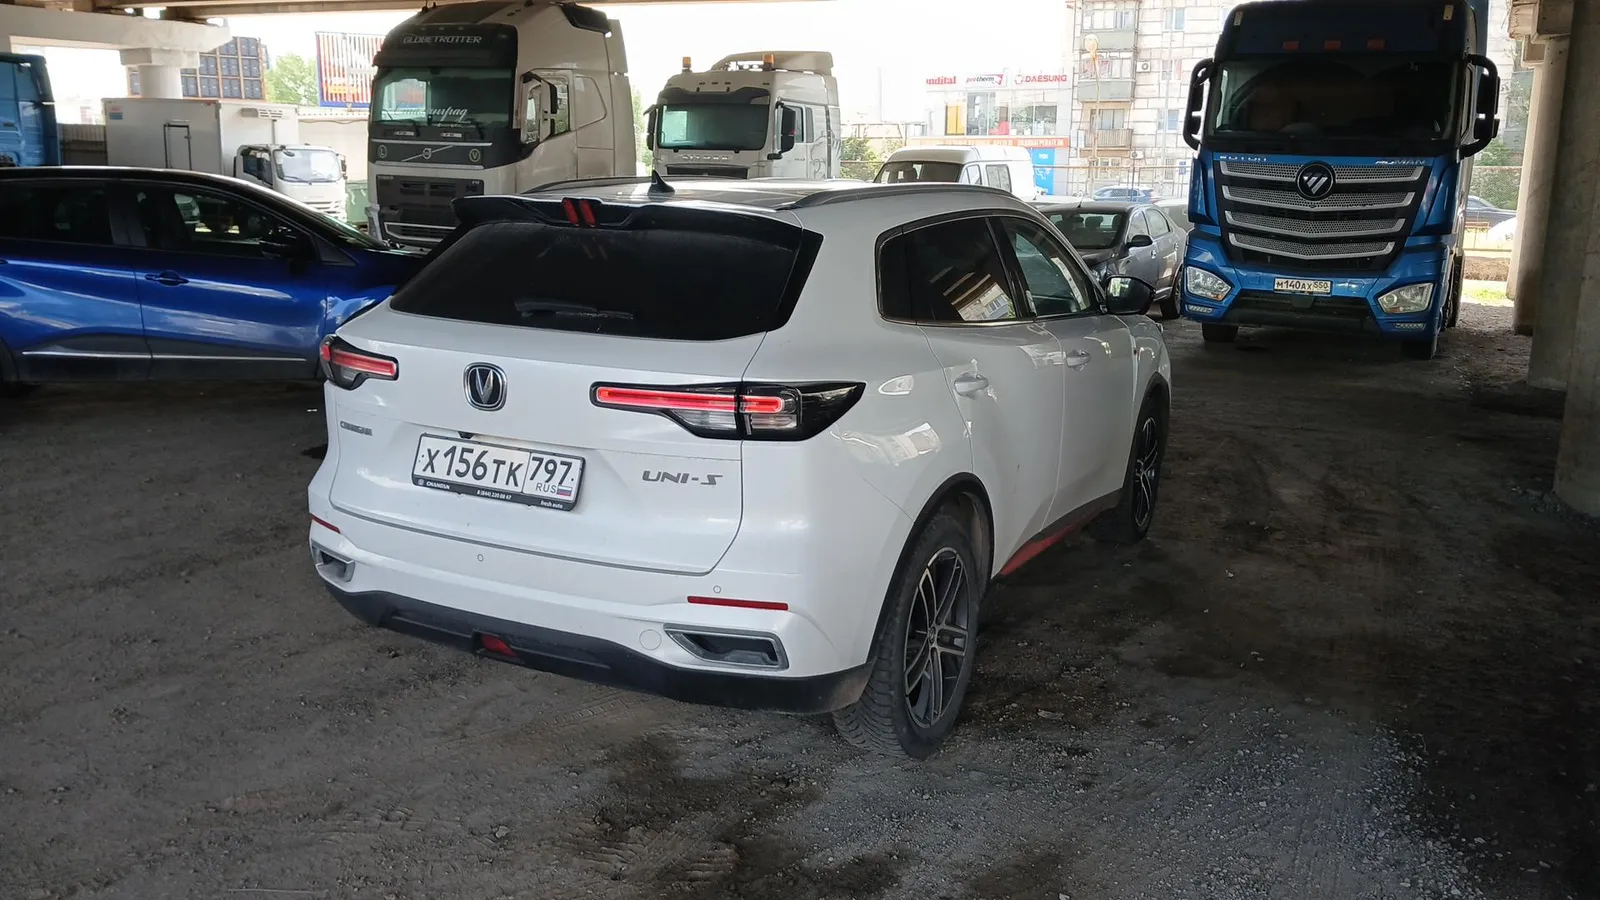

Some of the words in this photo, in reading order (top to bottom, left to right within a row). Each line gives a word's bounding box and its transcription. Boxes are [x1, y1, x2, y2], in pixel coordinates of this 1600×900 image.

[403, 35, 482, 44] GLOBETROTTER
[1025, 75, 1067, 83] DAESUNG
[422, 445, 524, 487] Х156ТК
[529, 456, 572, 486] 797
[642, 470, 723, 486] UNI-S
[535, 482, 557, 494] RUS
